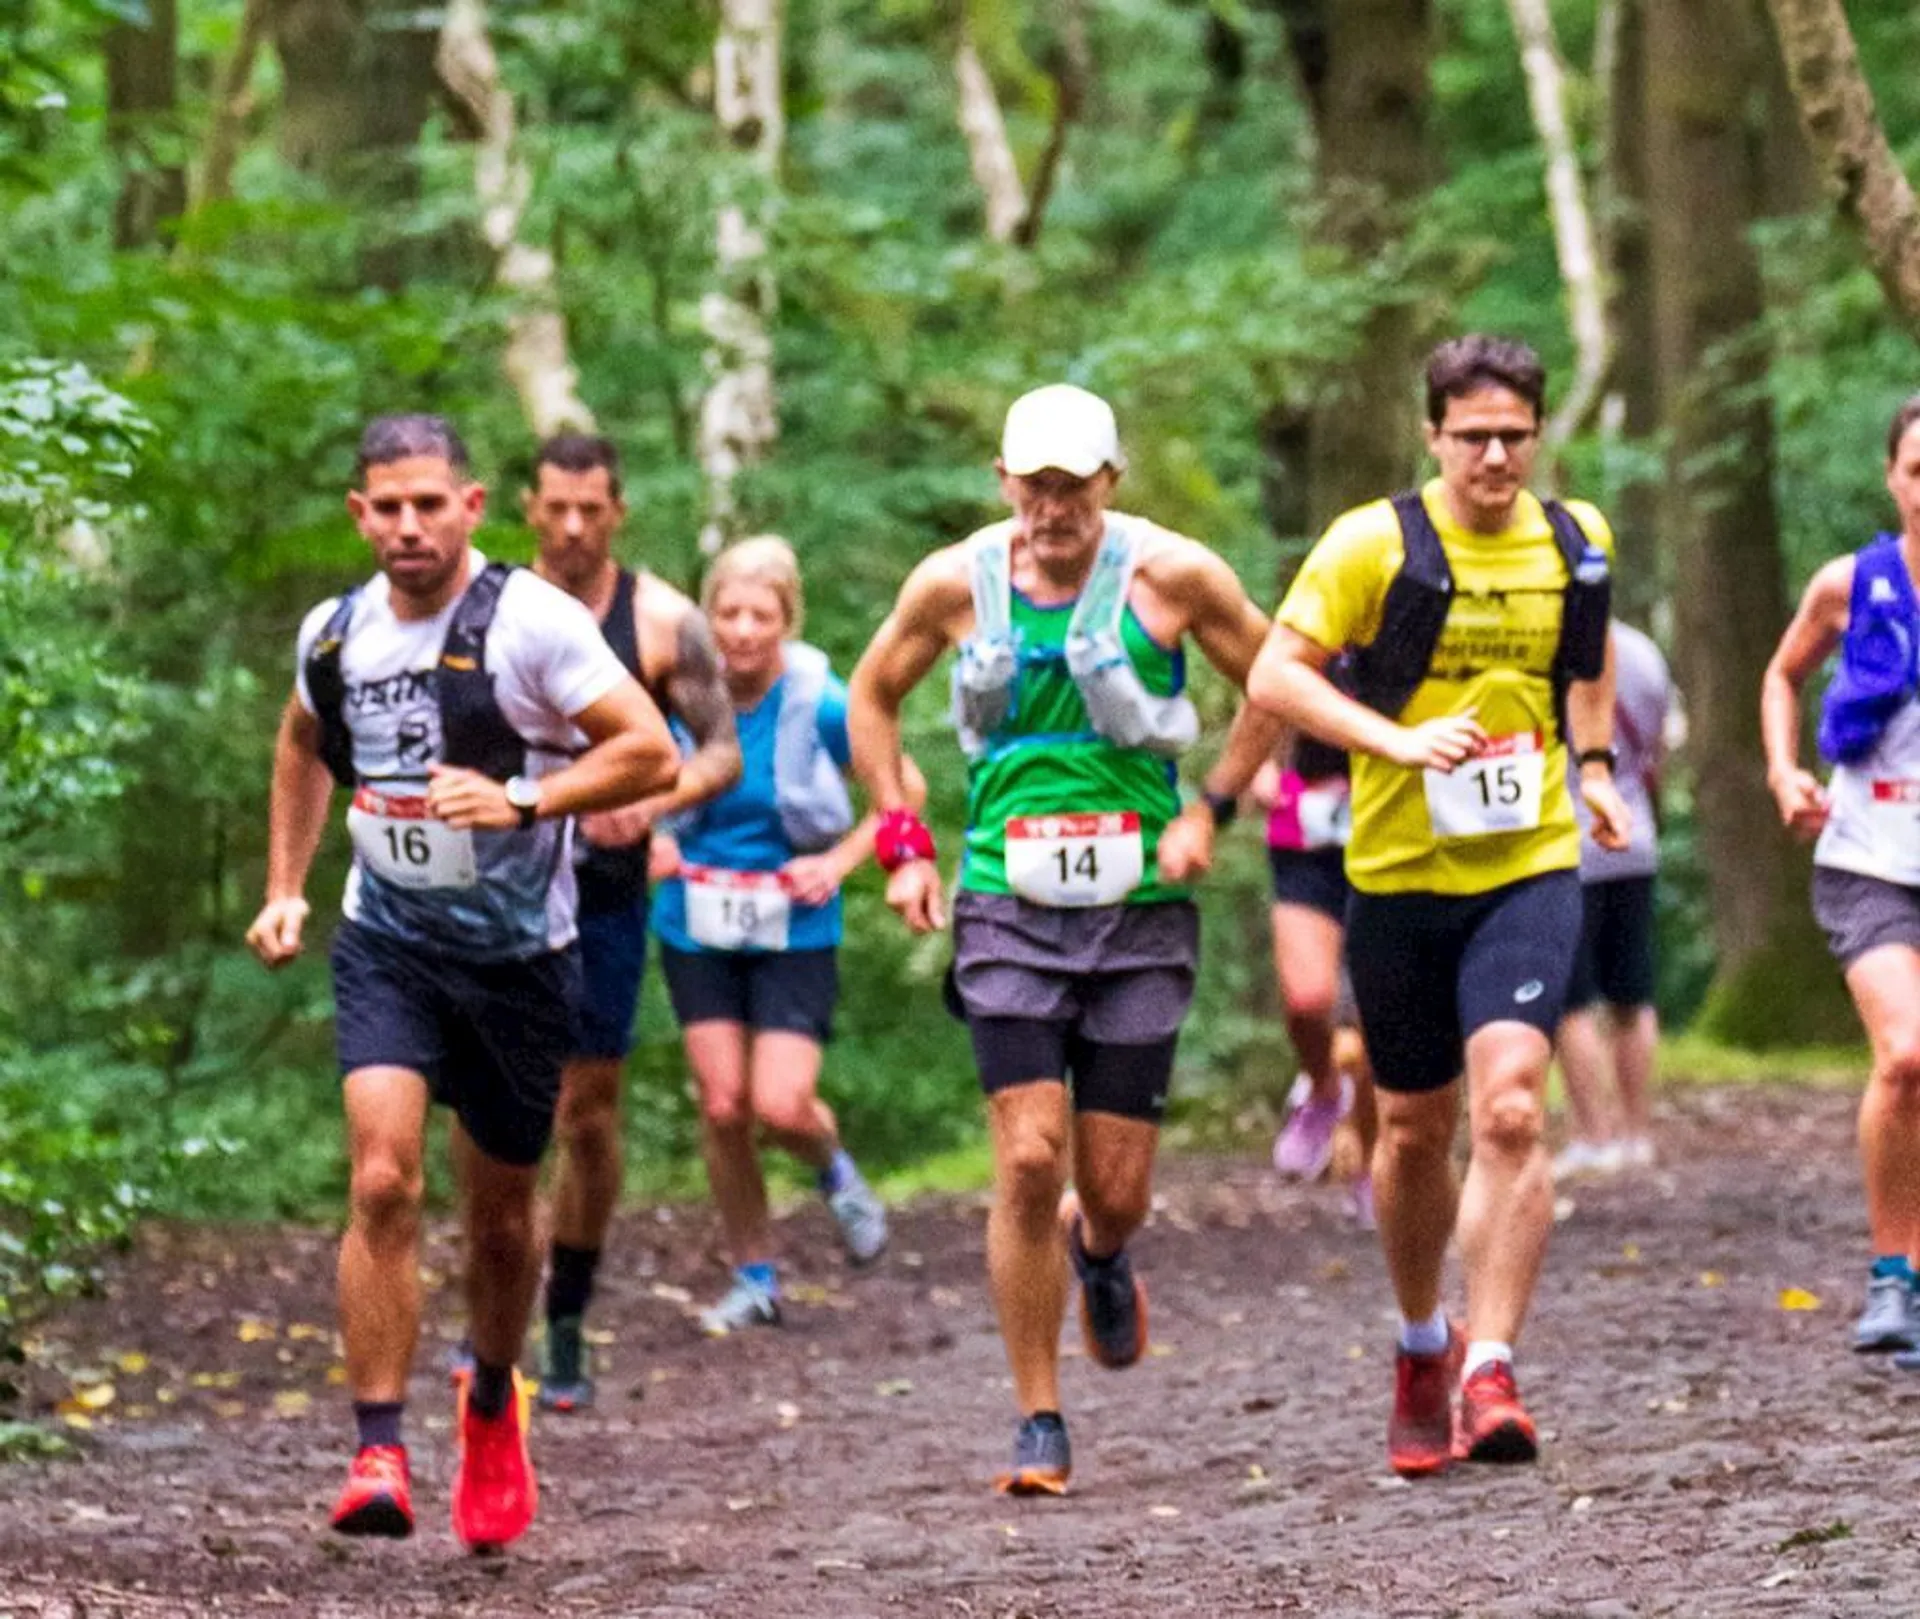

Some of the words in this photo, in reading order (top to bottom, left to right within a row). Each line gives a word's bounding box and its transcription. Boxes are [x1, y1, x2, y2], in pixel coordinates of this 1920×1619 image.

[1471, 764, 1521, 806] 15
[383, 825, 430, 865] 16
[1053, 845, 1100, 883] 14
